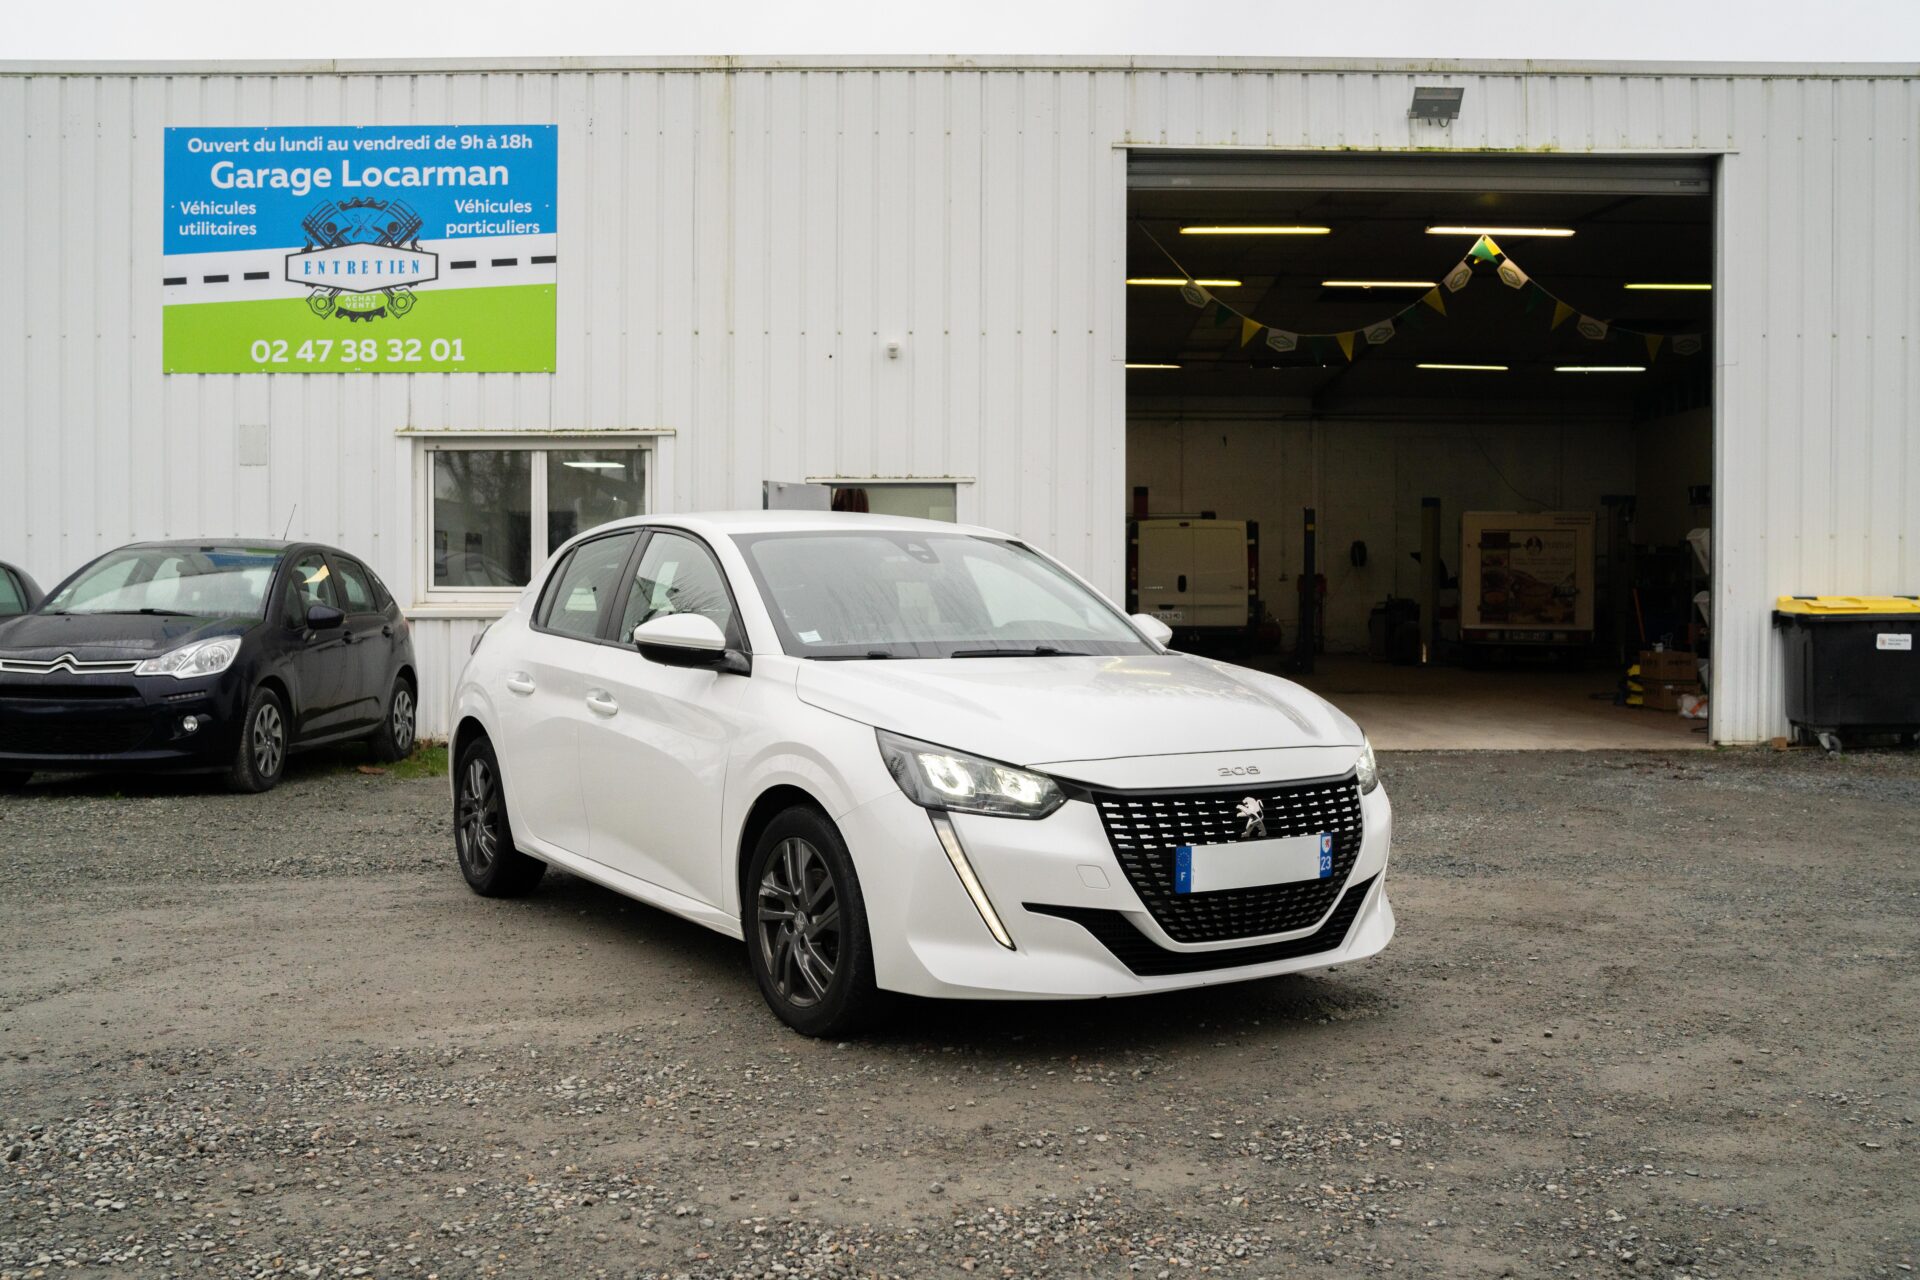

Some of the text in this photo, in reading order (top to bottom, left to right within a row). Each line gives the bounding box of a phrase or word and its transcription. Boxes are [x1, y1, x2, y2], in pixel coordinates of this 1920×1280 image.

[188, 135, 532, 152] Ouvert du lundi au vendredi de 9h à 18h
[211, 160, 508, 196] Garage Locarman
[181, 201, 256, 214] Véhicules
[455, 199, 532, 213] Véhicules
[180, 221, 256, 235] utilitaires
[446, 219, 540, 238] particuliers
[305, 261, 420, 274] ENTRETIEN
[251, 339, 464, 363] 02 47 38 32 01
[1320, 856, 1332, 871] 23
[1180, 872, 1186, 881] F
